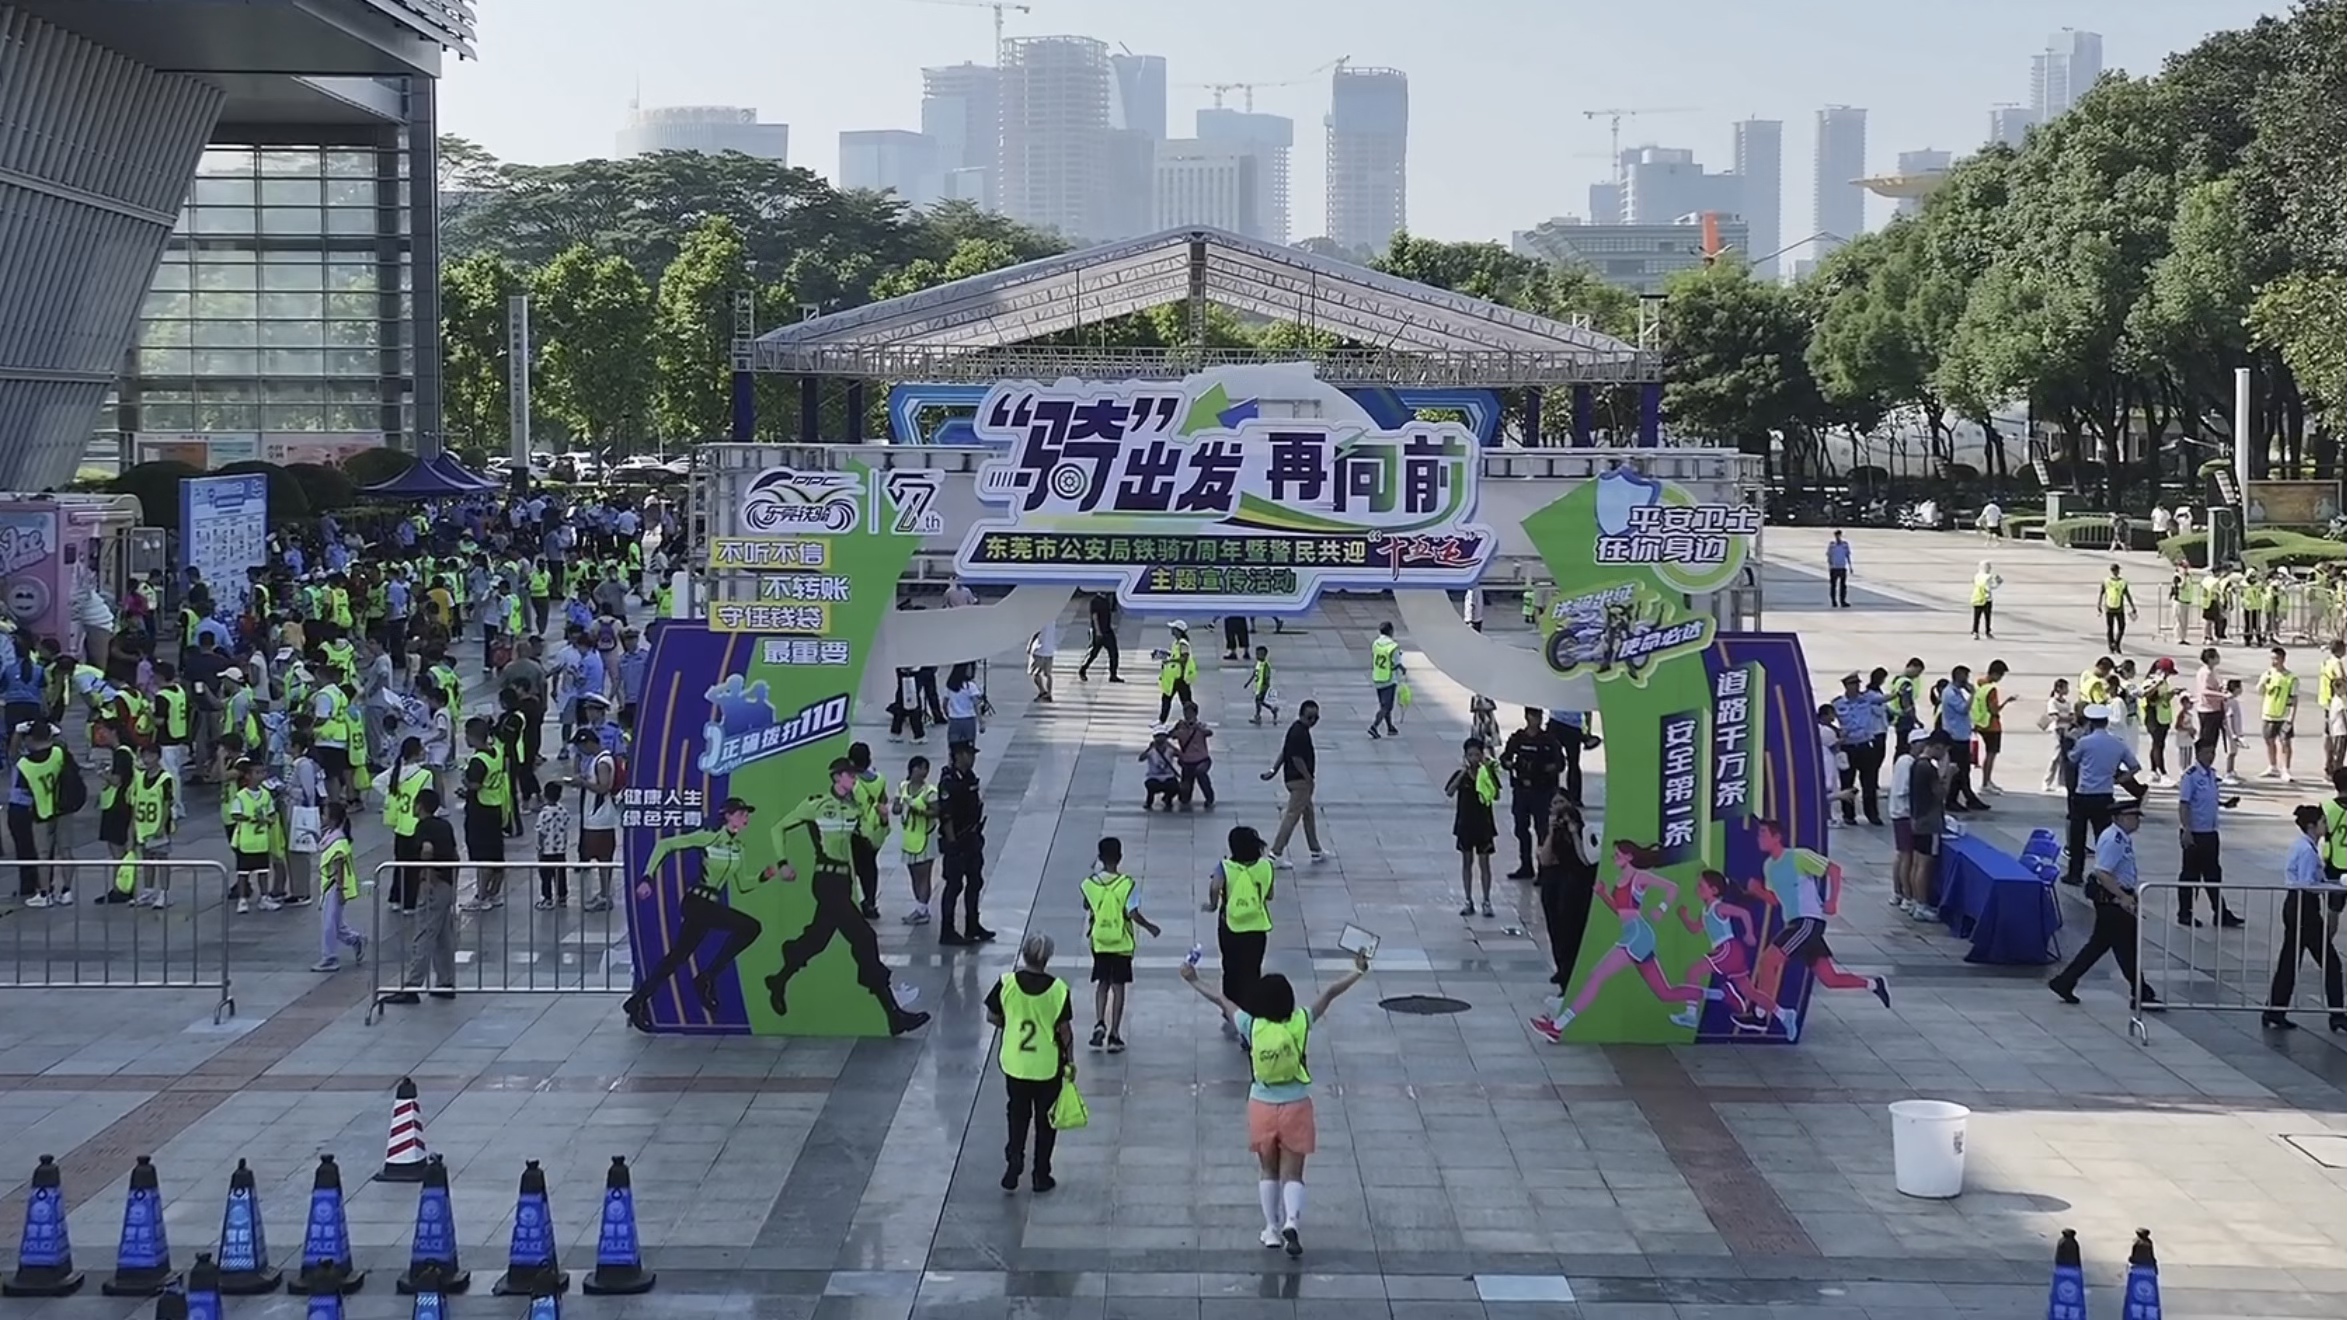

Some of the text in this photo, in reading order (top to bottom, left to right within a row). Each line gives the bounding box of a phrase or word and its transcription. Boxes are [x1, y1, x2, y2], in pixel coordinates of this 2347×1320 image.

[988, 393, 1467, 528] “骑”出发 再向前
[1629, 507, 1758, 532] 平安卫士
[717, 541, 823, 564] 不听不信
[1598, 537, 1728, 561] 在你身边
[763, 576, 849, 601] 不转账
[1150, 569, 1296, 593] 主题宣传活动
[717, 606, 822, 628] 守住钱袋
[1618, 621, 1704, 658] 使命必达
[763, 640, 848, 664] 最重要
[721, 696, 847, 763] 正确拨打110
[1716, 670, 1748, 807] 道路千万条
[1664, 720, 1696, 847] 安全第一条
[624, 789, 702, 806] 健康人生
[135, 801, 158, 823] 58
[622, 810, 702, 827] 绿色无毒
[1019, 1020, 1037, 1052] 2
